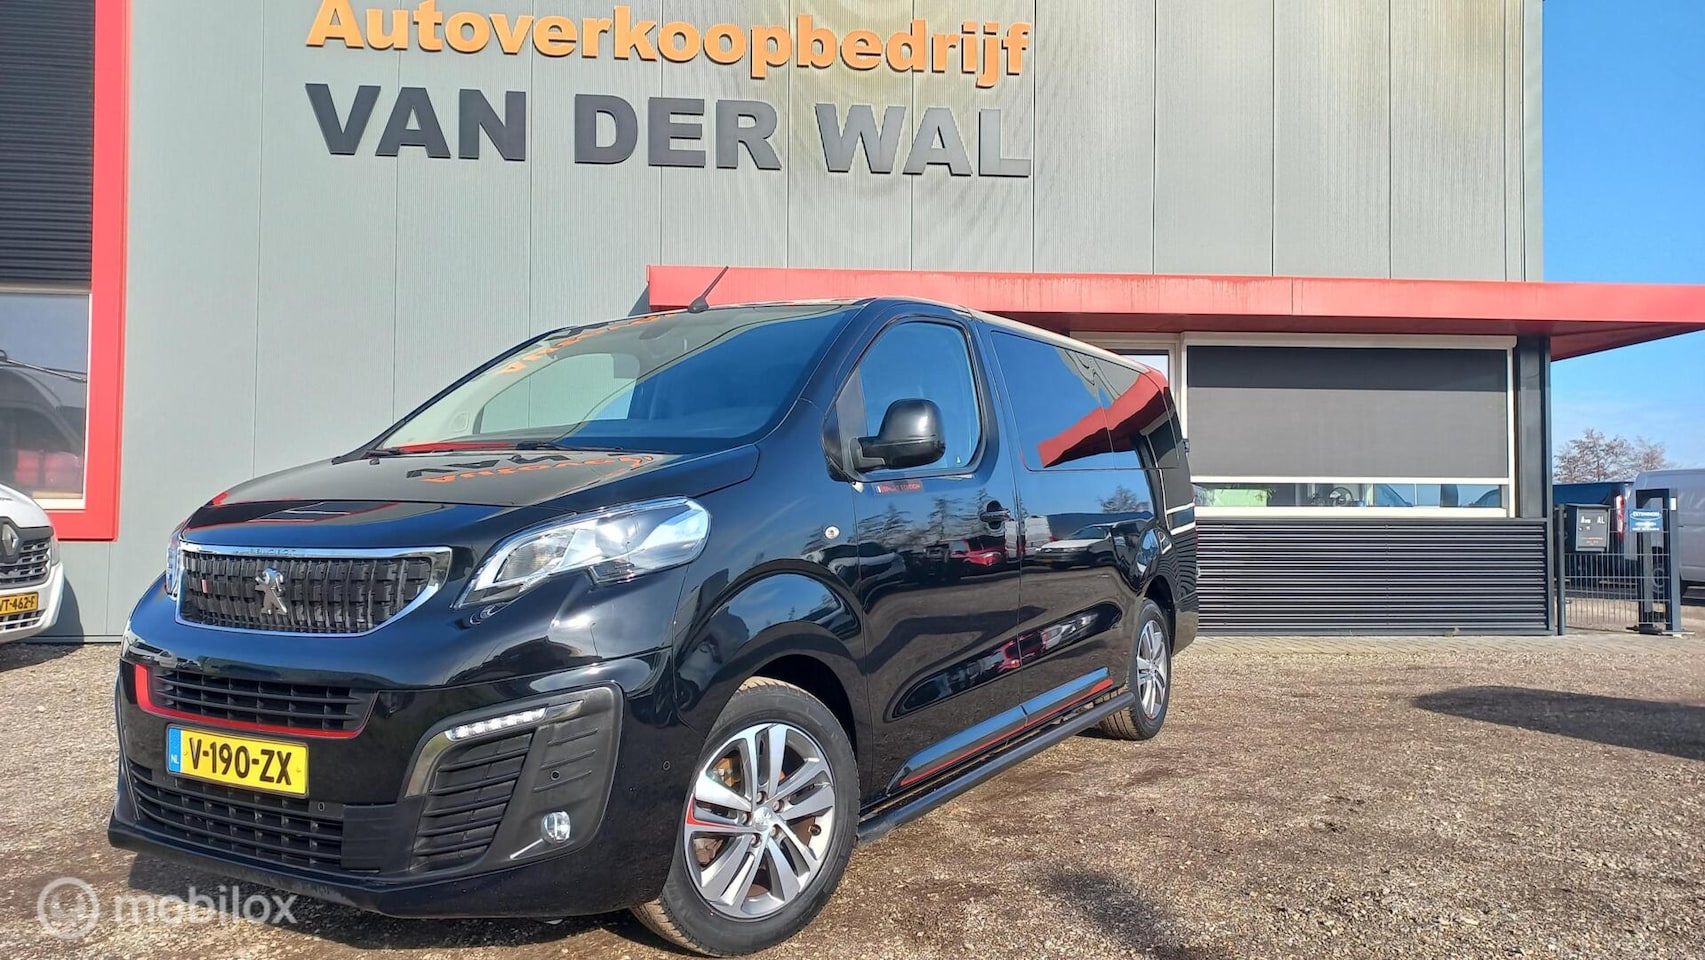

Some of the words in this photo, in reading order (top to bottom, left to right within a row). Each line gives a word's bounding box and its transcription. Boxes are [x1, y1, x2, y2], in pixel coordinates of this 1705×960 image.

[306, 0, 1031, 88] Autoverkoopbedrijf
[304, 83, 527, 161] VAN
[574, 94, 782, 171] DER
[815, 103, 1033, 177] WAL
[189, 737, 292, 786] V-190-ZX
